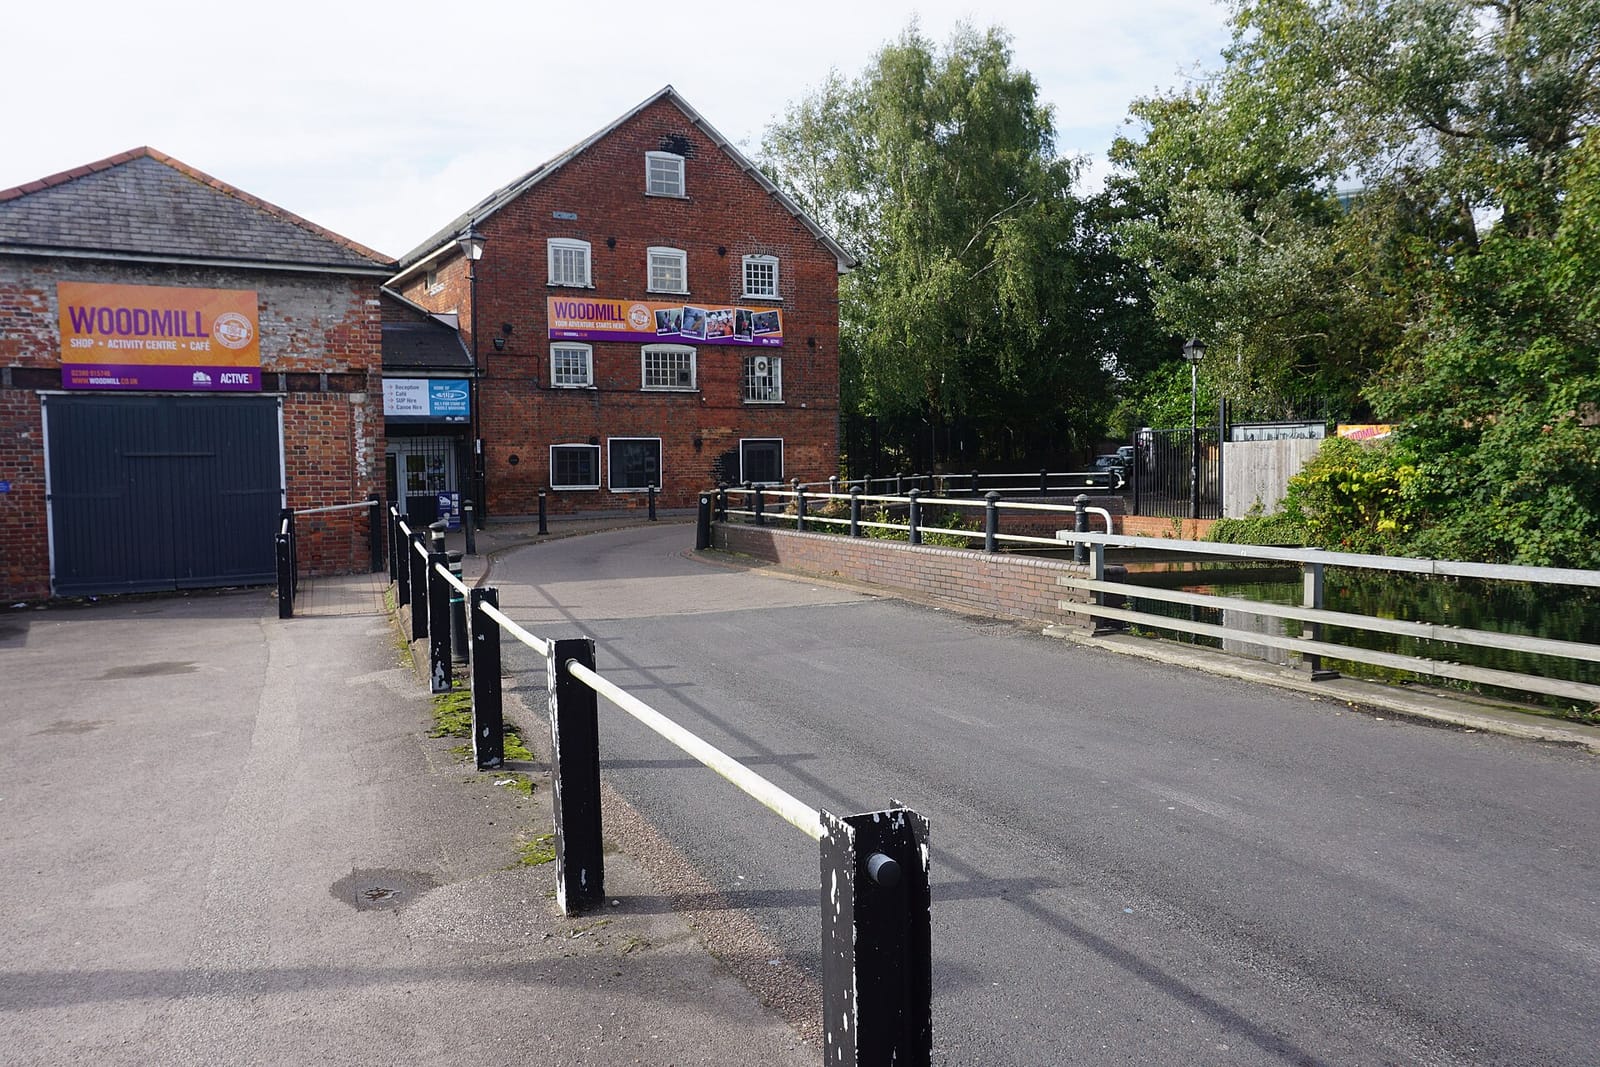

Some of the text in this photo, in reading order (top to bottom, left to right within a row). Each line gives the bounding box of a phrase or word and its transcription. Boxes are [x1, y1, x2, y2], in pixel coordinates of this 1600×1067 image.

[554, 302, 625, 321] WOODMILL
[68, 306, 209, 338] WOODMILL
[70, 338, 210, 351] SHOP ACTIVITY CENTRE CAFÉ
[71, 377, 138, 385] WWW.WOODMILL.CO.UK
